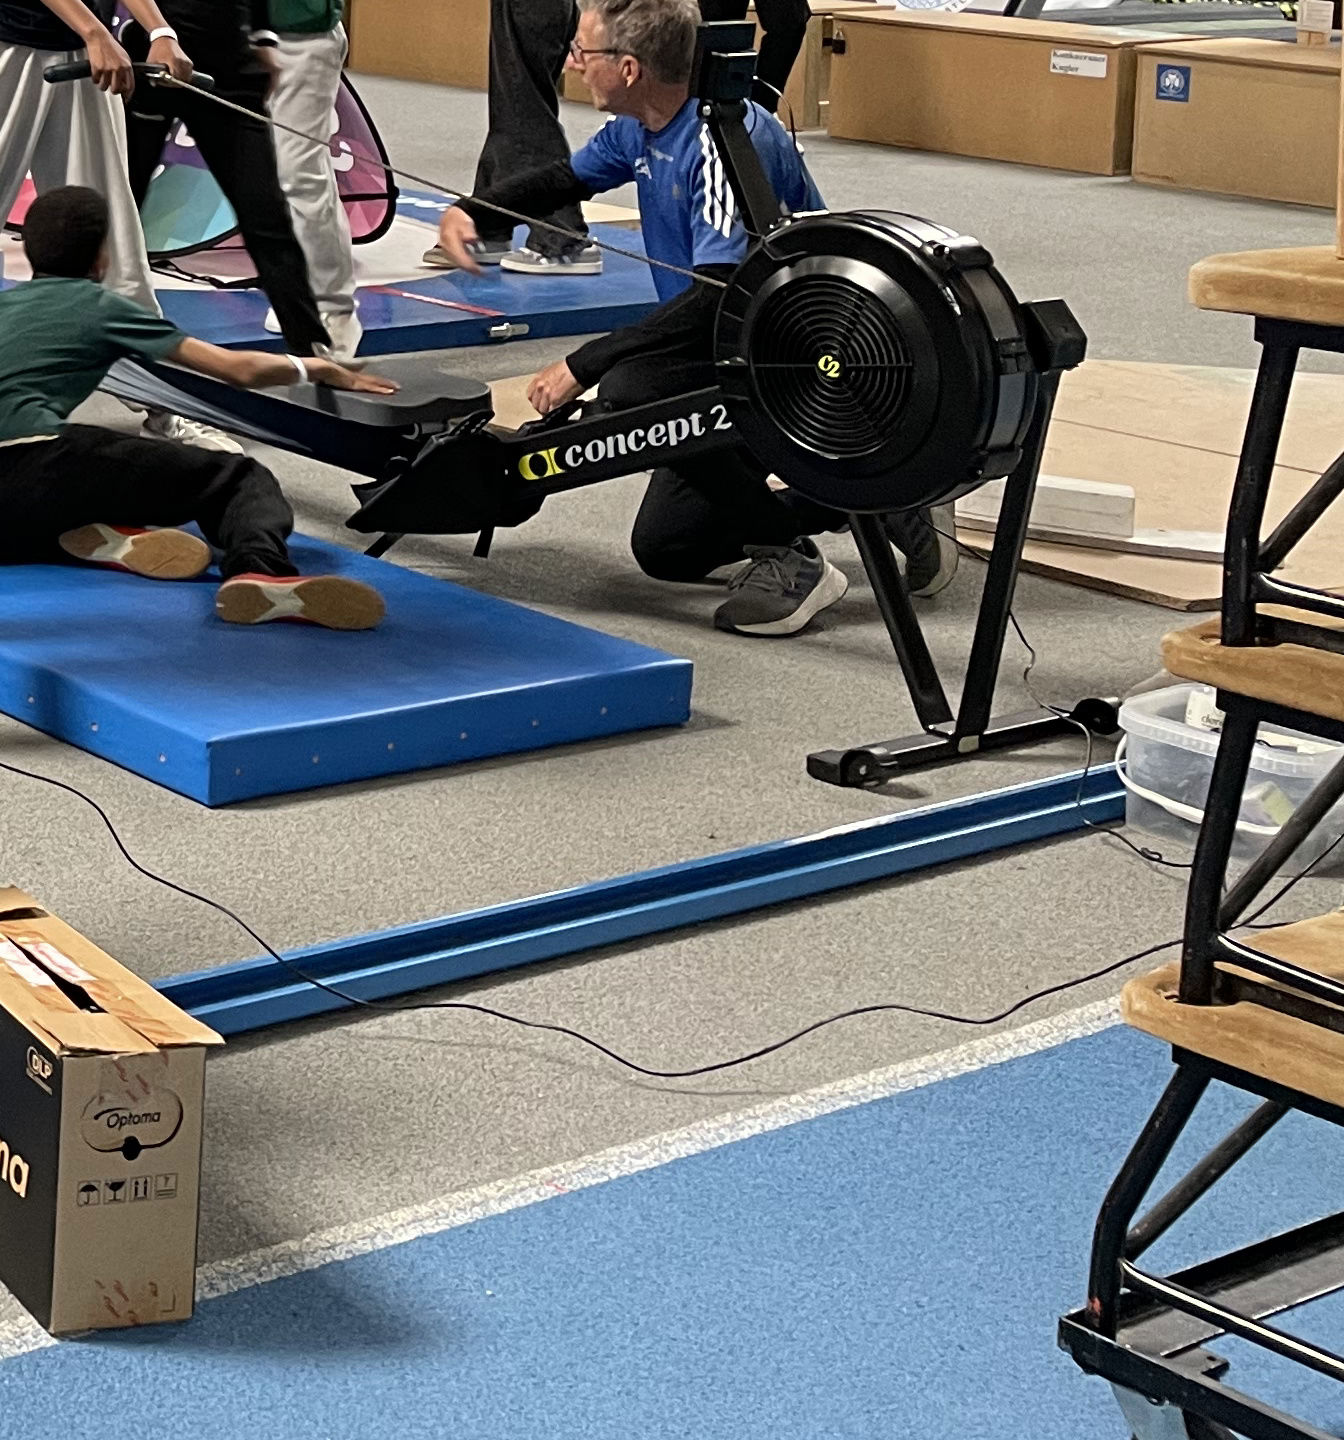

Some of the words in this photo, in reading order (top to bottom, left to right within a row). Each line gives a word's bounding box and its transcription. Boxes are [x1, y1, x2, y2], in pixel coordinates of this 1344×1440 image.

[564, 410, 706, 469] concept
[709, 403, 733, 432] 2
[106, 1110, 162, 1132] Optoma
